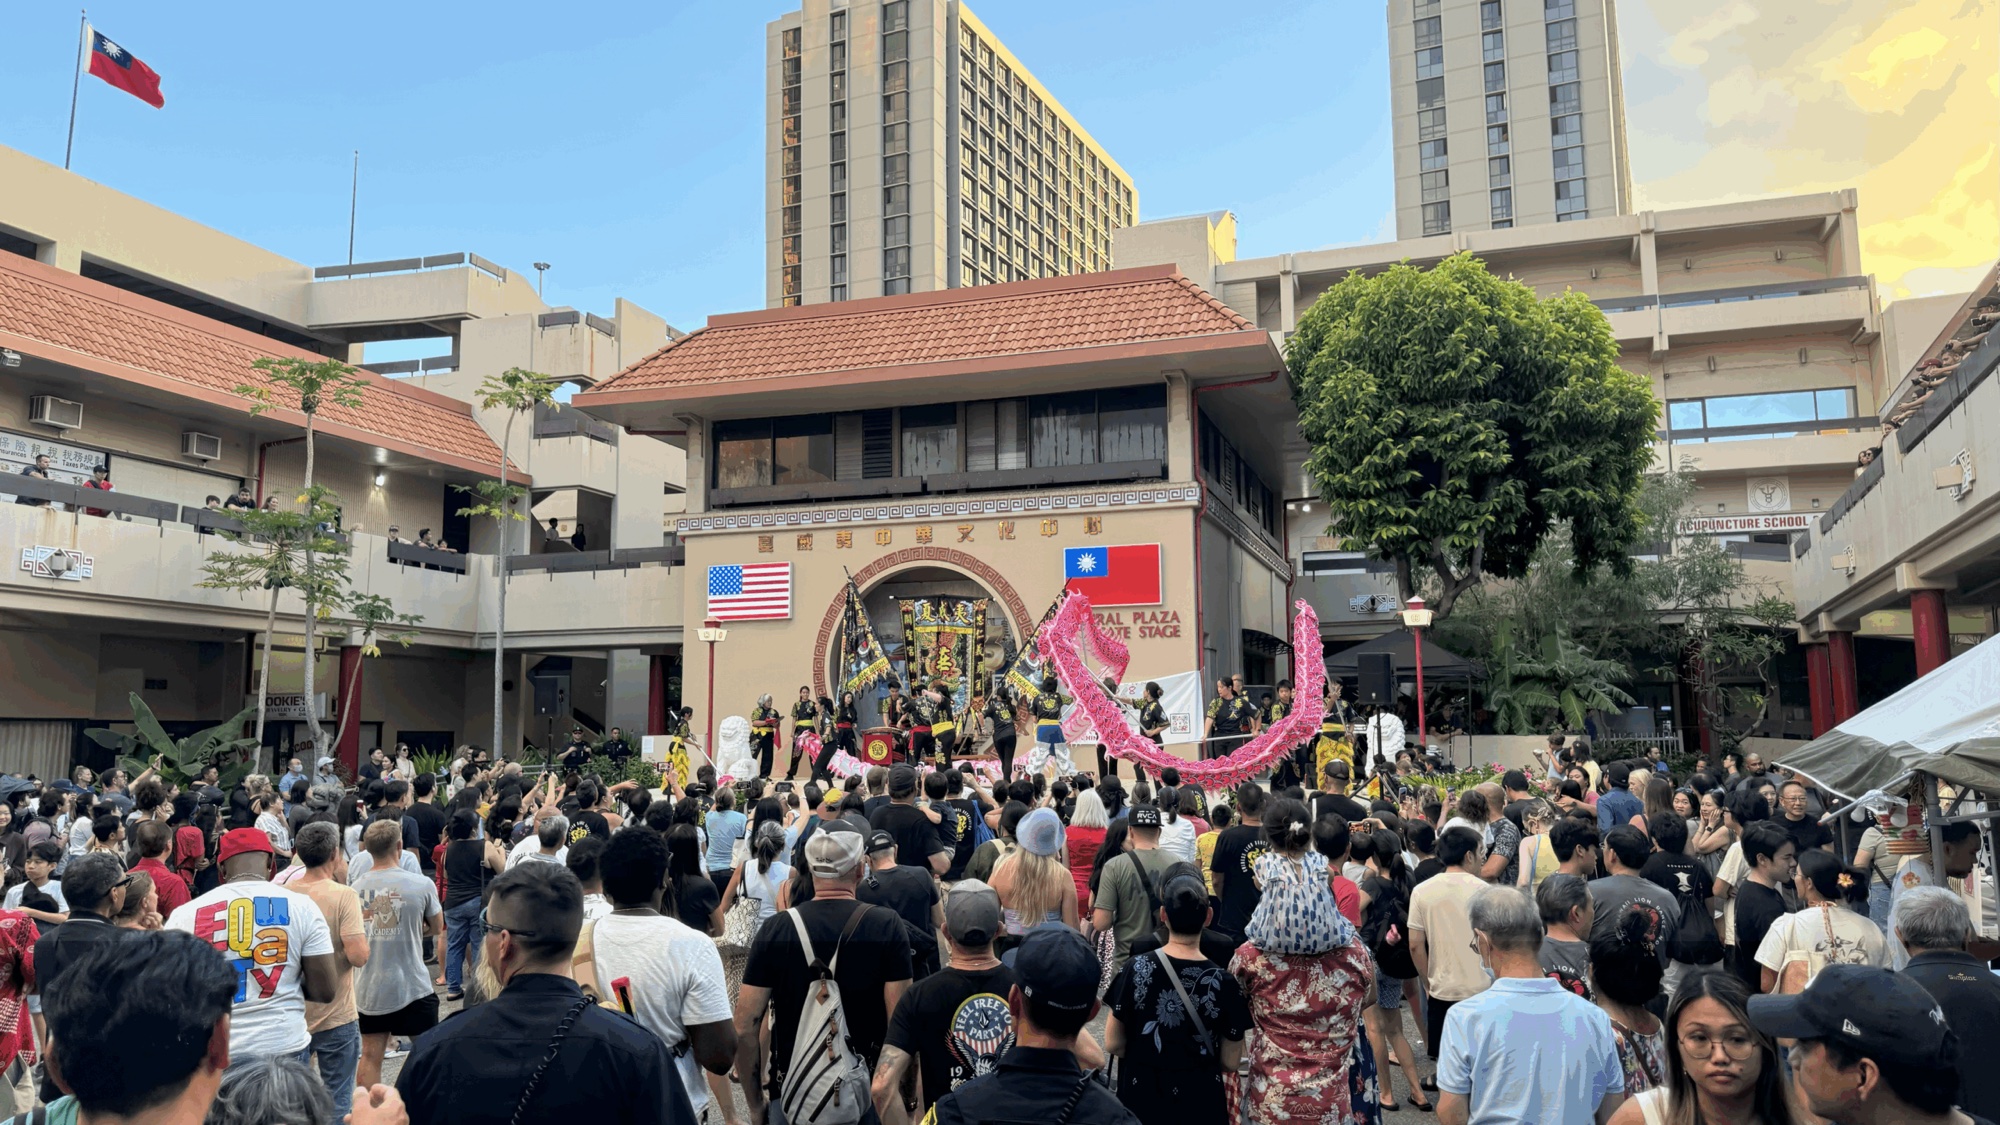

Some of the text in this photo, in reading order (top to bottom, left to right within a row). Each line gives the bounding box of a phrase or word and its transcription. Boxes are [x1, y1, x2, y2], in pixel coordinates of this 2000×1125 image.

[62, 459, 79, 469] Taxes
[1679, 518, 1761, 532] ACUPUNCTURE
[1763, 515, 1809, 528] SCHOOL
[1132, 610, 1181, 625] PLAZA
[1138, 625, 1181, 638] STAGE
[1634, 897, 1652, 905] LION
[1553, 964, 1575, 974] LION
[955, 998, 1012, 1030] FEEL FREE TO
[969, 1024, 1003, 1040] PARTY
[950, 1066, 963, 1077] 19
